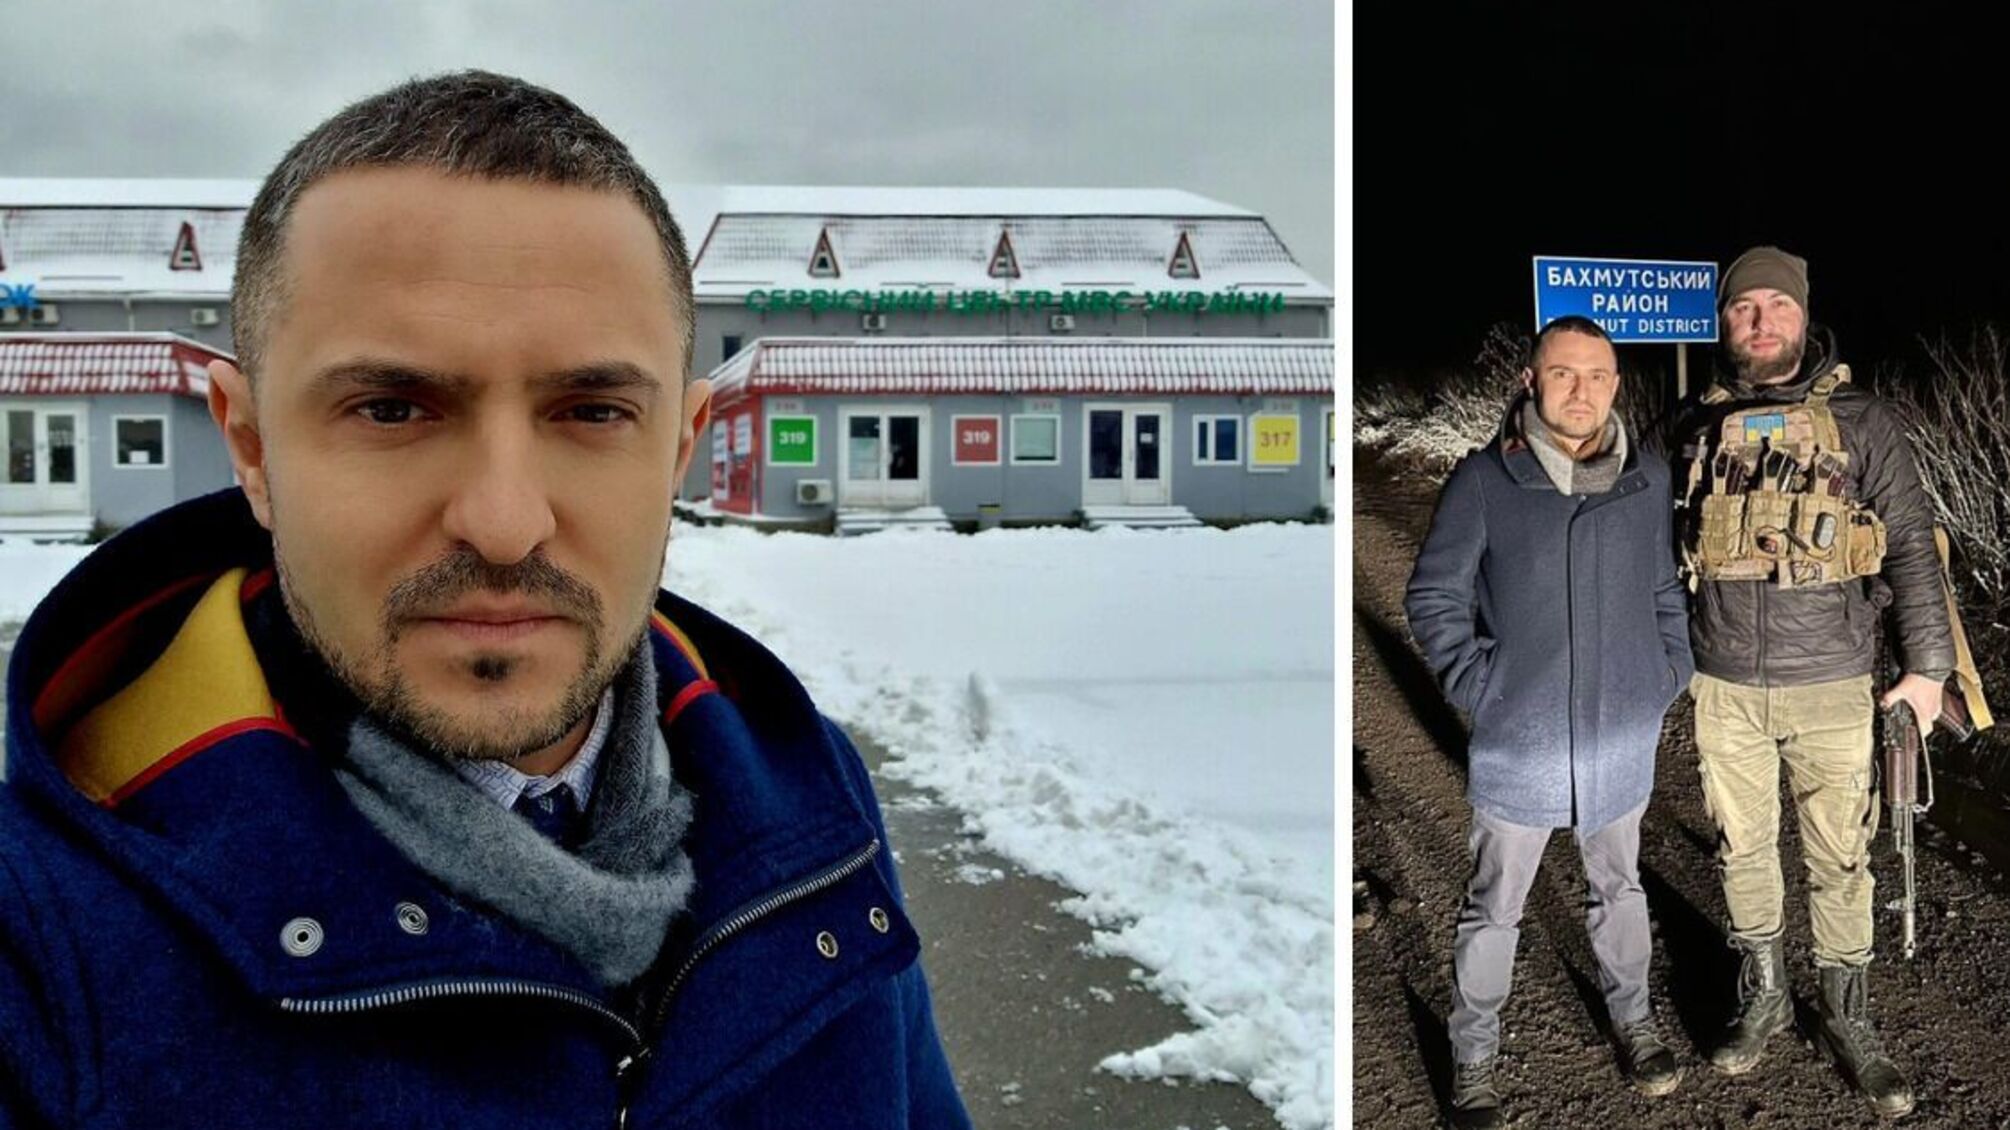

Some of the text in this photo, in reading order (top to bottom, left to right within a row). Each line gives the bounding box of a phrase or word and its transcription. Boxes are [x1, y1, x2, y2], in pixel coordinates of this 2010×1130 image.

[1547, 266, 1711, 290] БАХМУТСЬКИЙ
[1592, 289, 1669, 313] РАЙОН
[1638, 318, 1711, 334] DISTRICT
[779, 430, 807, 445] 319
[963, 430, 991, 445] 319
[1260, 431, 1291, 448] 317
